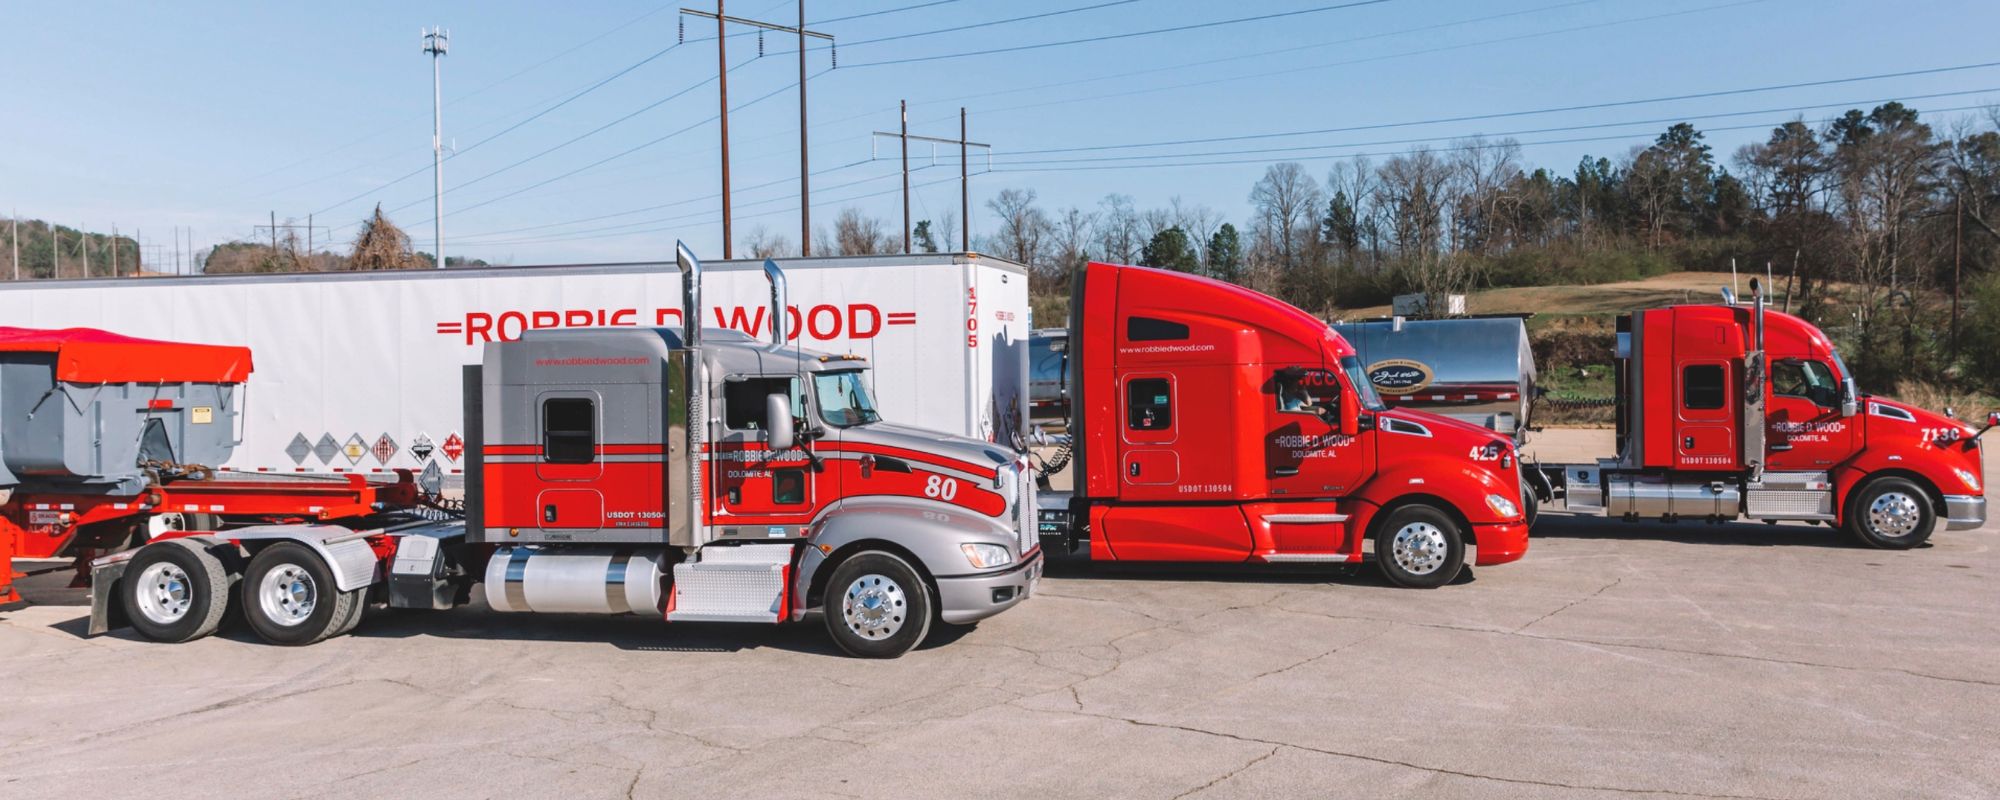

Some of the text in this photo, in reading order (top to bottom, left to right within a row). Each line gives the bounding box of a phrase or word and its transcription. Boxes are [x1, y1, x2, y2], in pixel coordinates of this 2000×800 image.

[967, 287, 977, 347] 1705
[1120, 344, 1215, 354] www.robbiedwood.com
[535, 356, 650, 366] www.robbiedwood.com
[1328, 449, 1337, 458] AL
[1469, 446, 1499, 461] 425
[924, 474, 957, 501] 80
[1178, 484, 1232, 493] USDOT 130504
[606, 510, 667, 519] USDOT 130504
